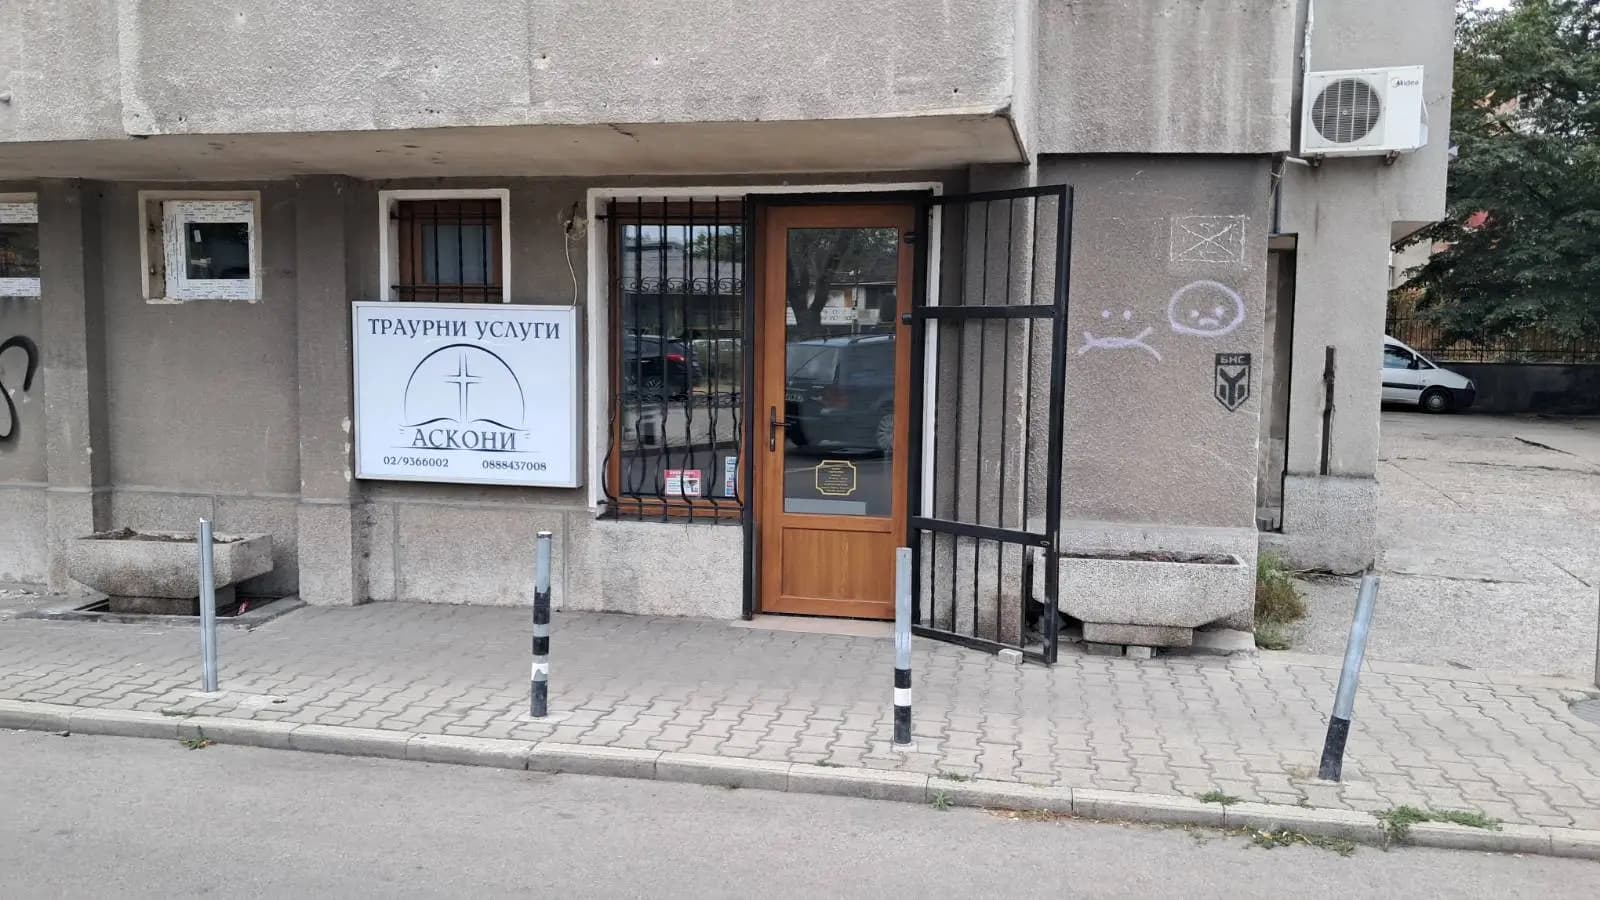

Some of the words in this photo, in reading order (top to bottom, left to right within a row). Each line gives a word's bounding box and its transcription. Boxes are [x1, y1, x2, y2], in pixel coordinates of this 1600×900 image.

[368, 318, 467, 339] ТРАУРНИ
[475, 320, 560, 342] УСЛУГИ
[411, 428, 517, 450] АСКОНИ
[383, 456, 449, 468] 02/9366002
[482, 460, 547, 471] 0888437008
